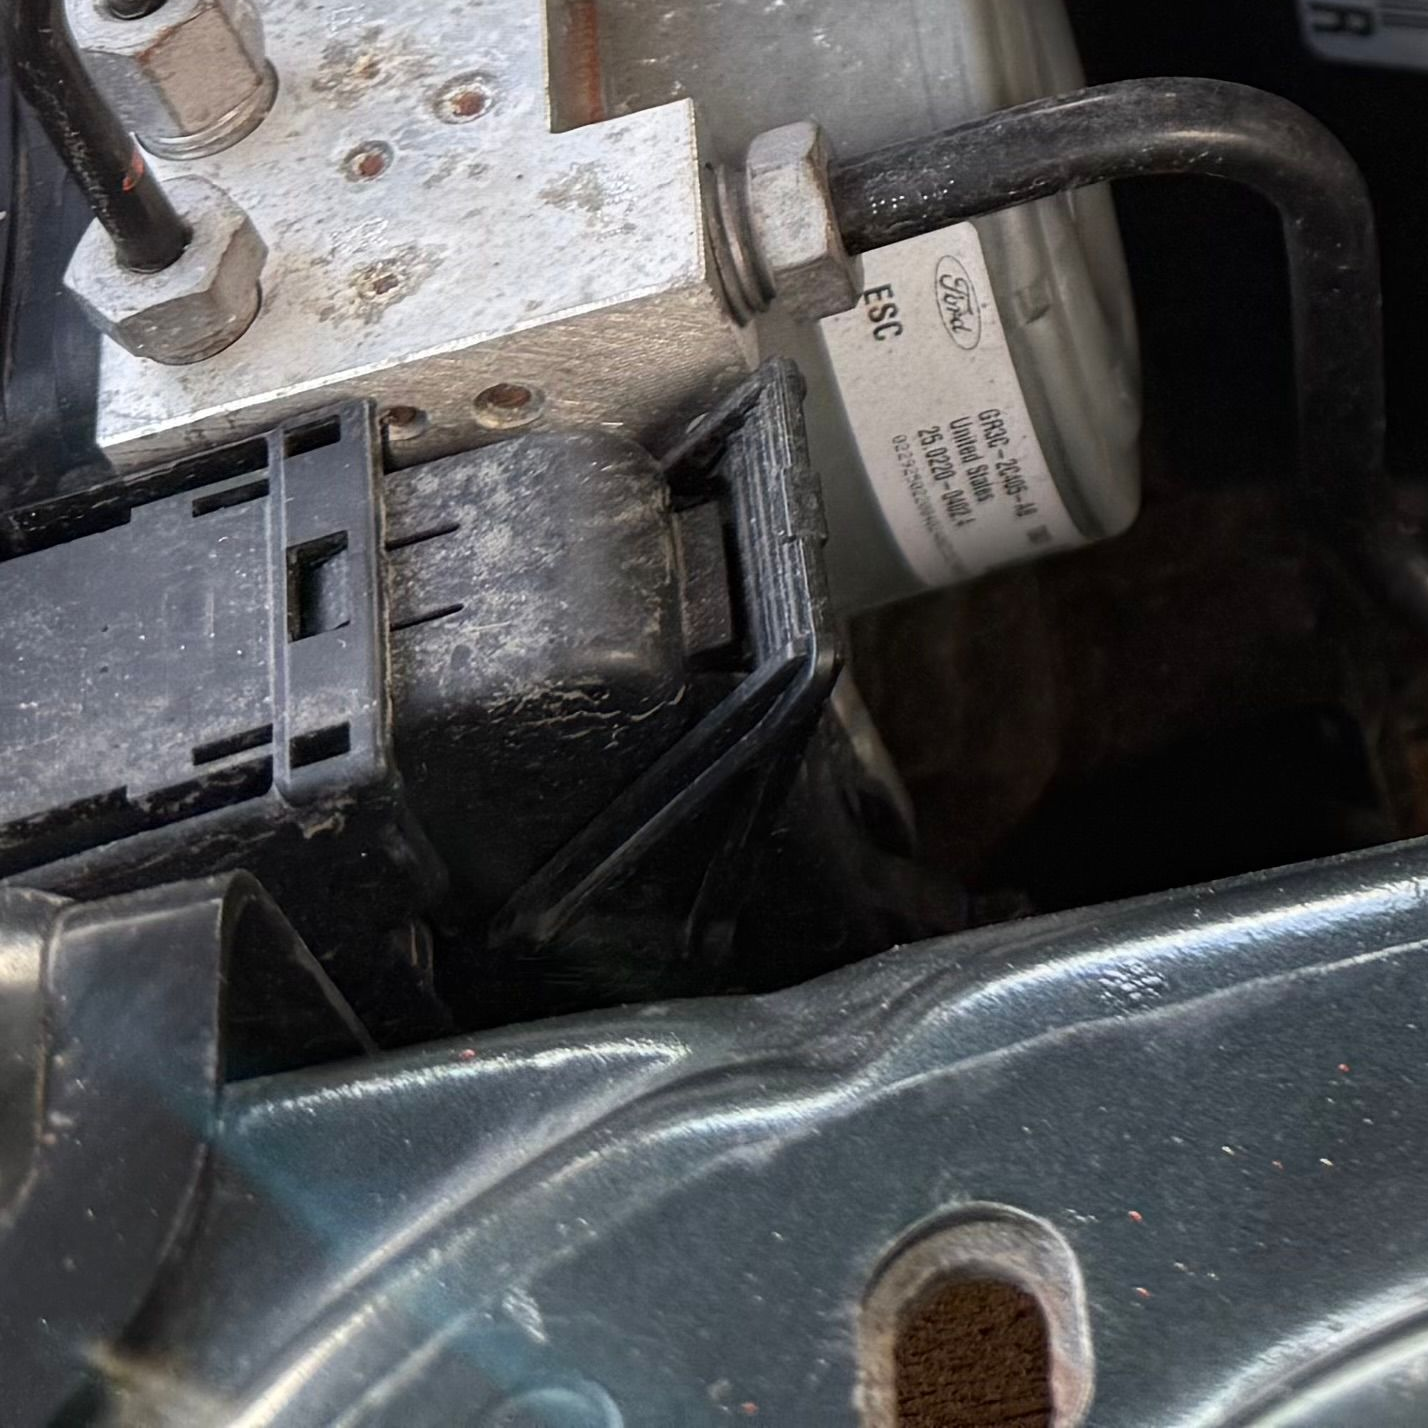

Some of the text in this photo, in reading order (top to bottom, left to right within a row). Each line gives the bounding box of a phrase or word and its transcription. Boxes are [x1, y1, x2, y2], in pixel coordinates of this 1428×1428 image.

[1309, 0, 1376, 38] R
[863, 283, 904, 342] ESC
[937, 271, 975, 337] Ford
[949, 416, 996, 505] United States
